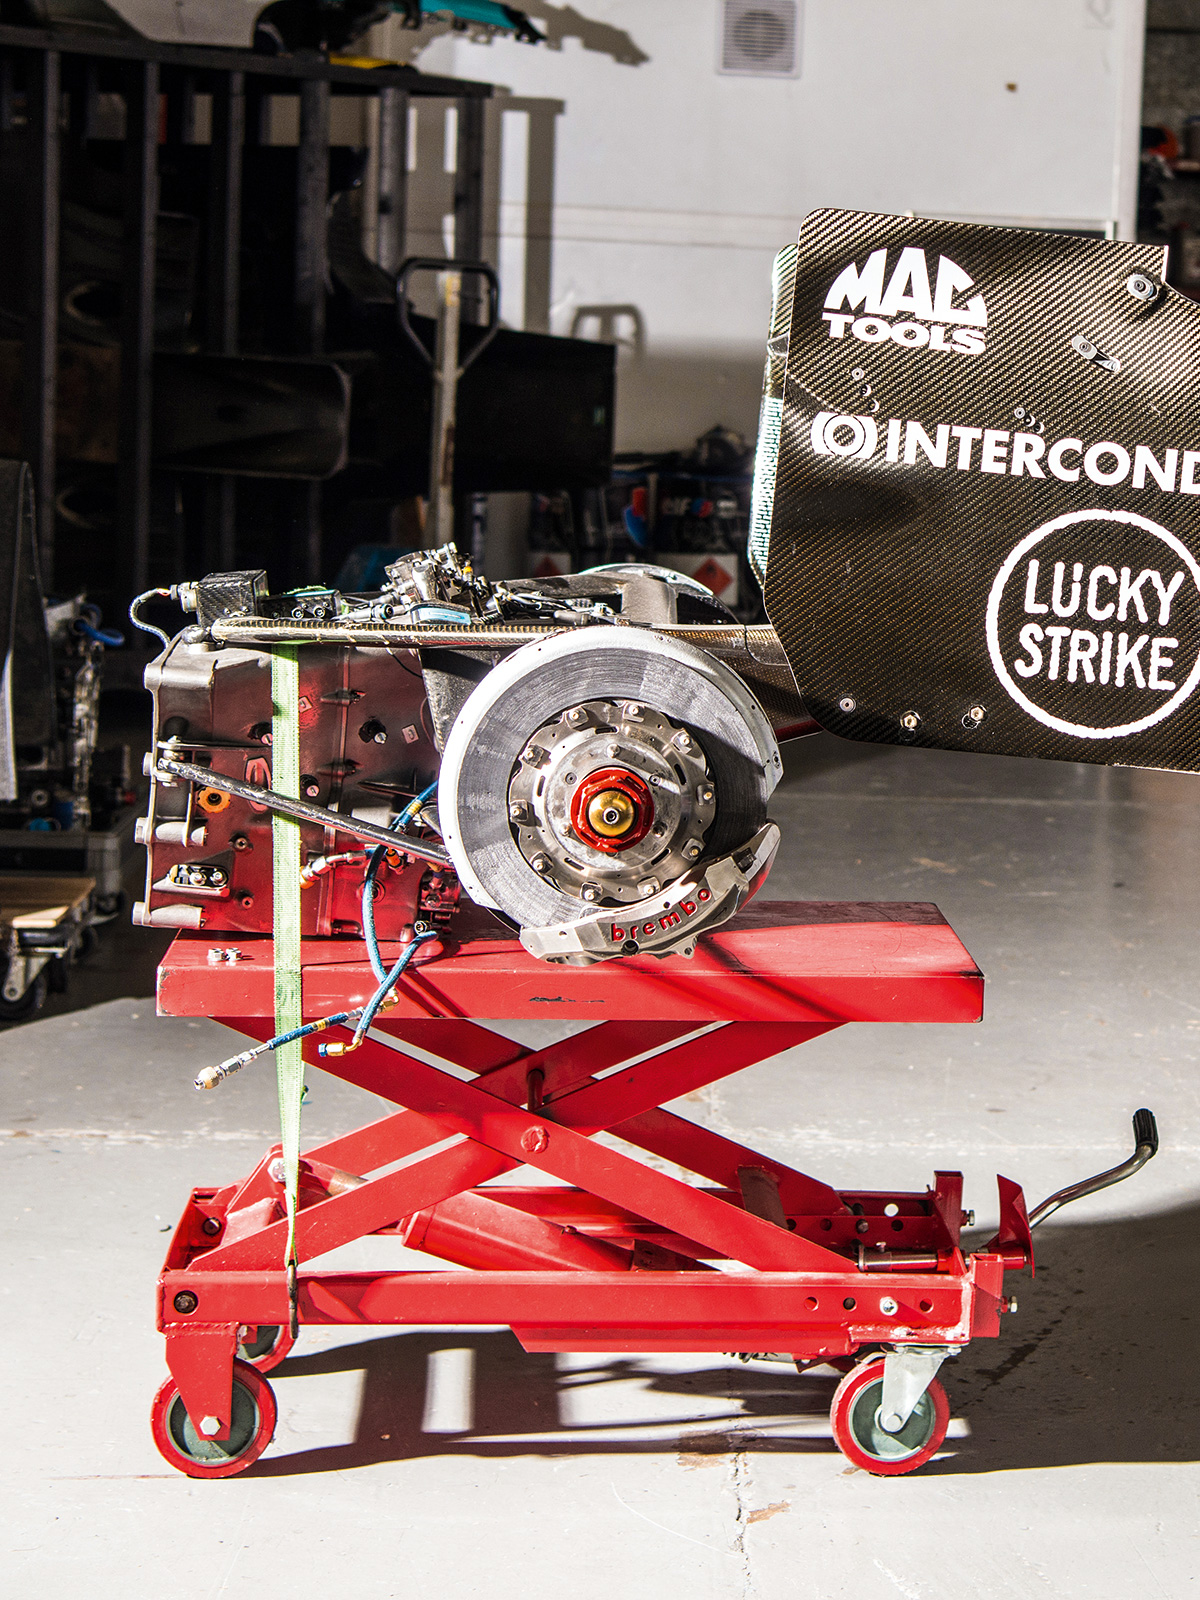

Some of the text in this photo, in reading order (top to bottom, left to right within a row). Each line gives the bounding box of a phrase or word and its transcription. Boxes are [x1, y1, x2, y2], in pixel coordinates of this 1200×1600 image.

[824, 246, 989, 327] MAC
[821, 311, 987, 356] TOOLS
[1024, 558, 1187, 626] LUCKY
[1014, 626, 1180, 692] STRIKE
[610, 888, 712, 942] brembo
